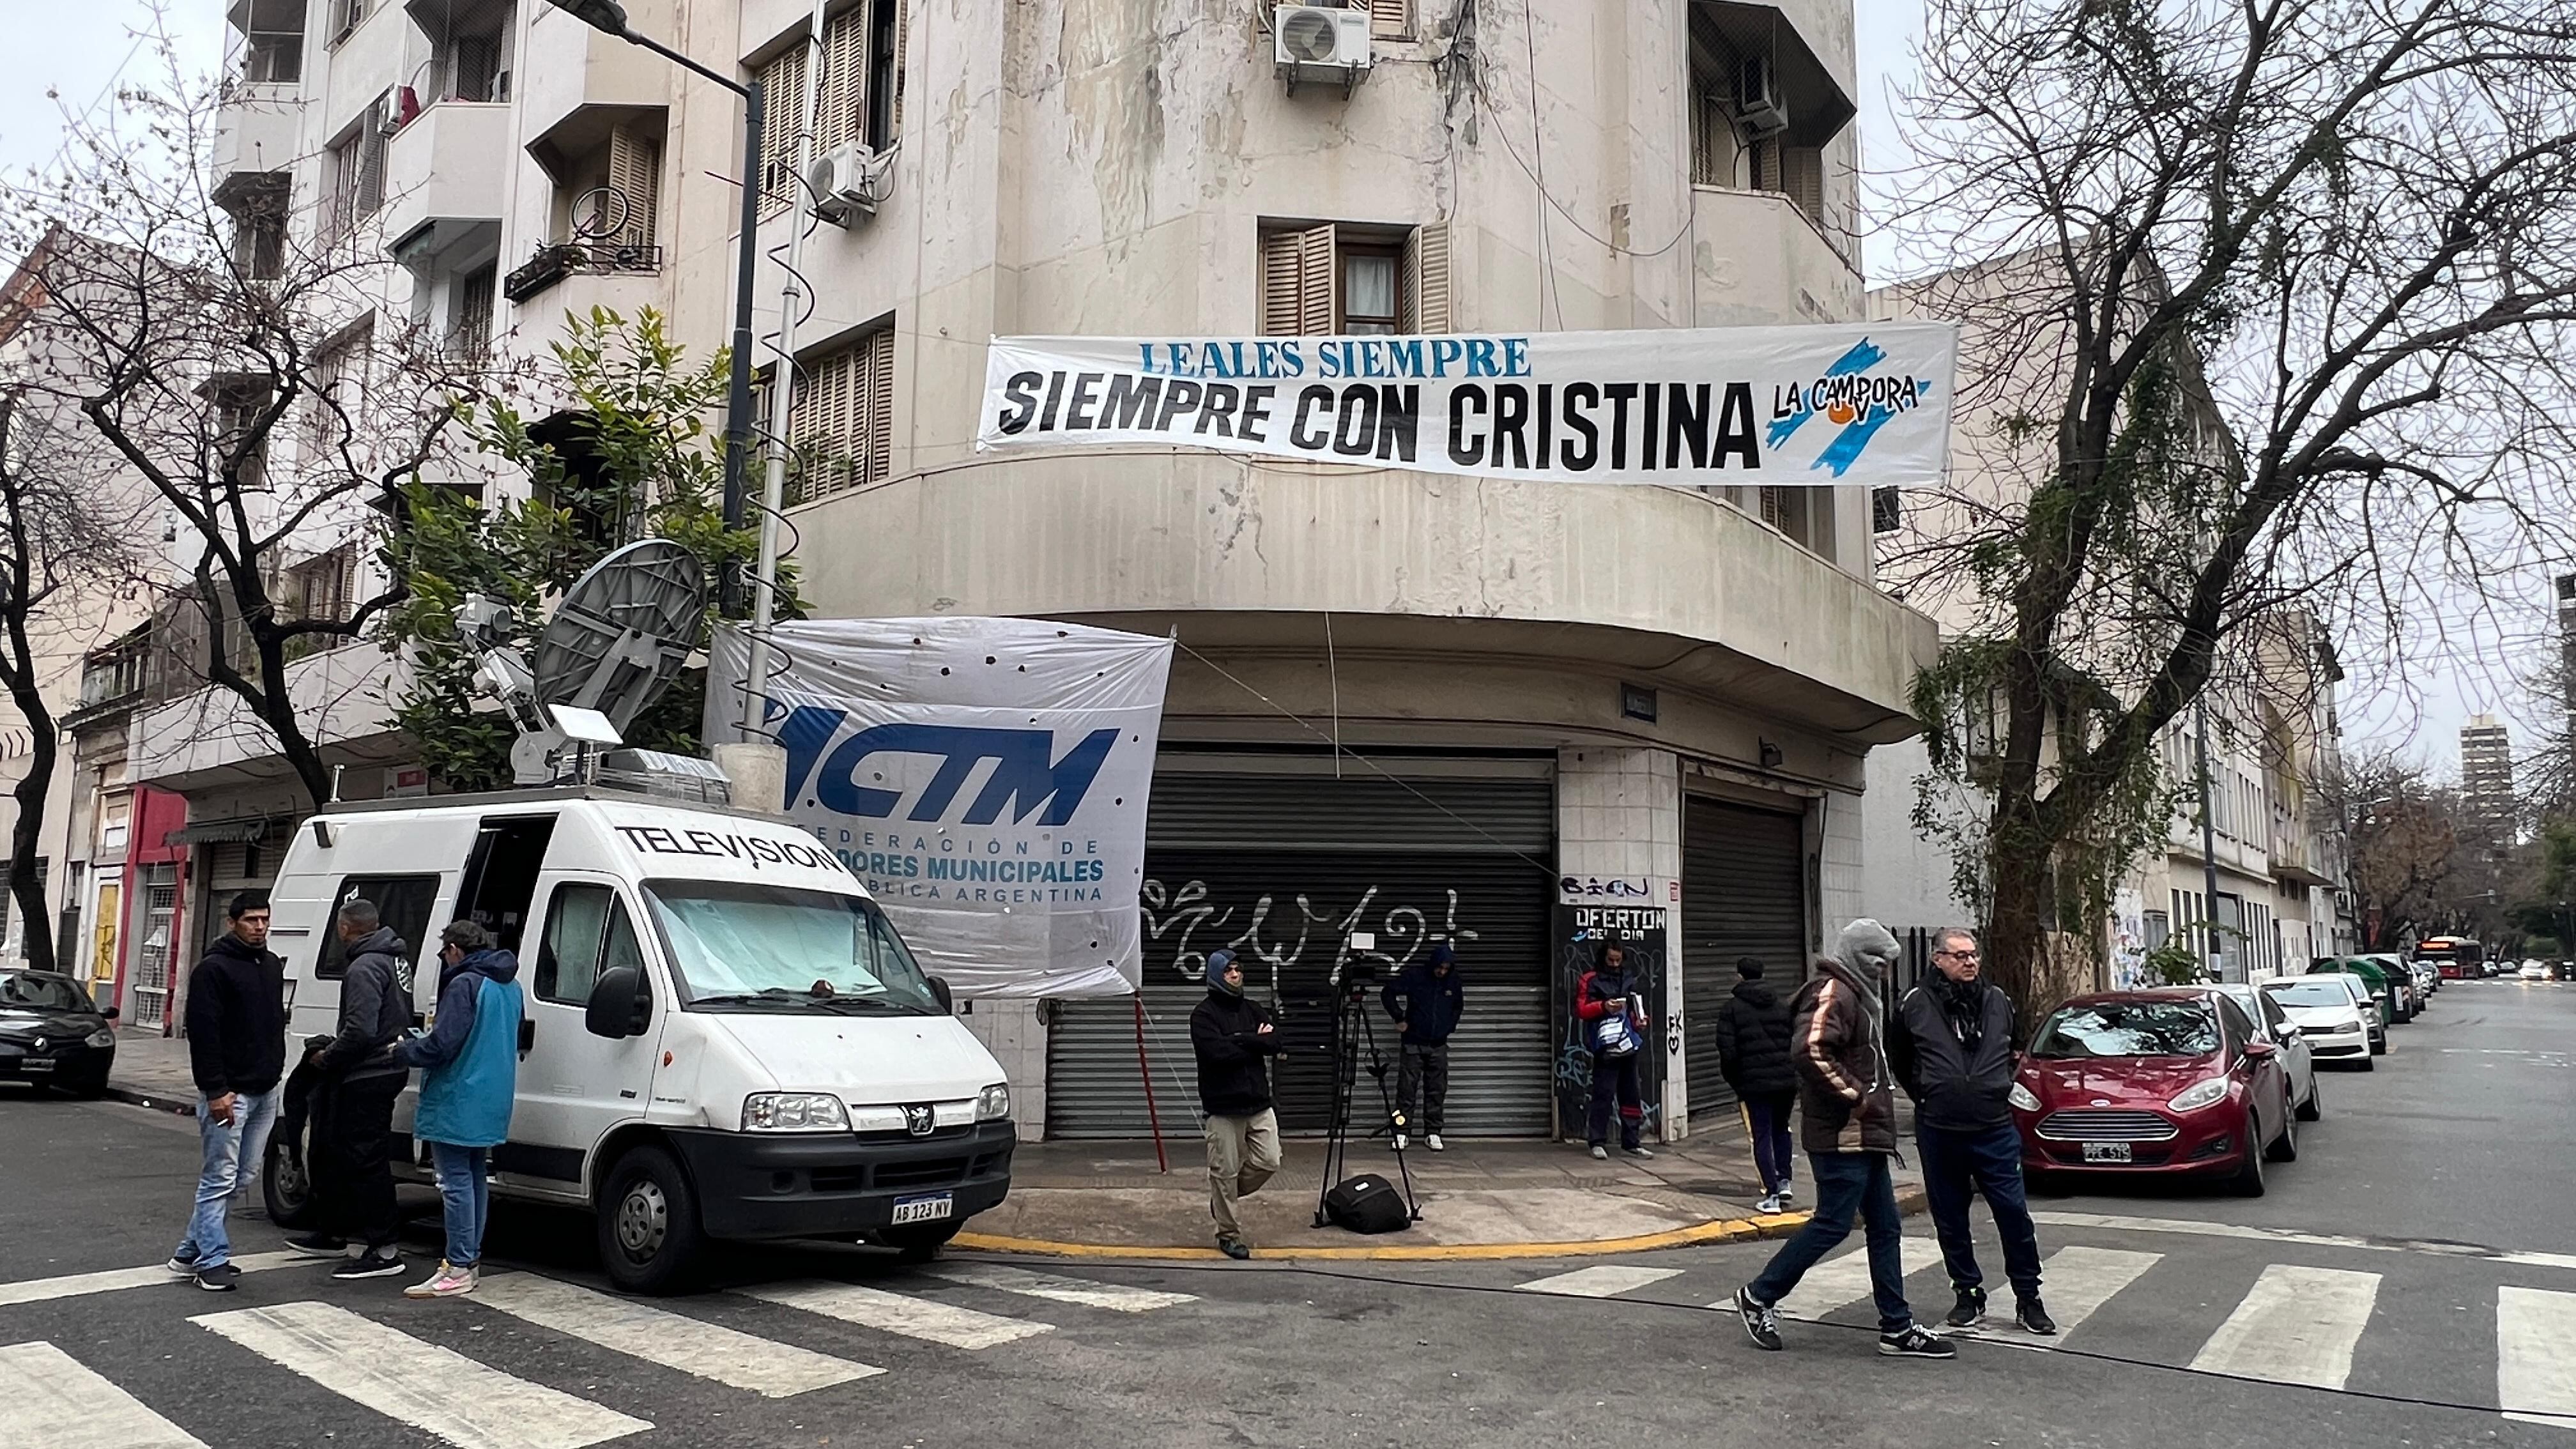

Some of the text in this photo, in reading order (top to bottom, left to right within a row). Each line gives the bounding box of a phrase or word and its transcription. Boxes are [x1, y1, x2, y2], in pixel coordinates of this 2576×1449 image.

[1139, 337, 1531, 379] LEALES SIEMPRE
[1773, 375, 1919, 422] LA CAMPORA
[999, 371, 1761, 470] SIEMPRE CON CRISTINA
[1062, 840, 1096, 854] DE
[928, 860, 1103, 882] MUNICIPALES
[956, 888, 1102, 902] ARGENTINA
[1575, 908, 1665, 929] OFERTON
[1621, 930, 1644, 940] DIA
[896, 1206, 910, 1222] AB
[912, 1202, 933, 1219] 123
